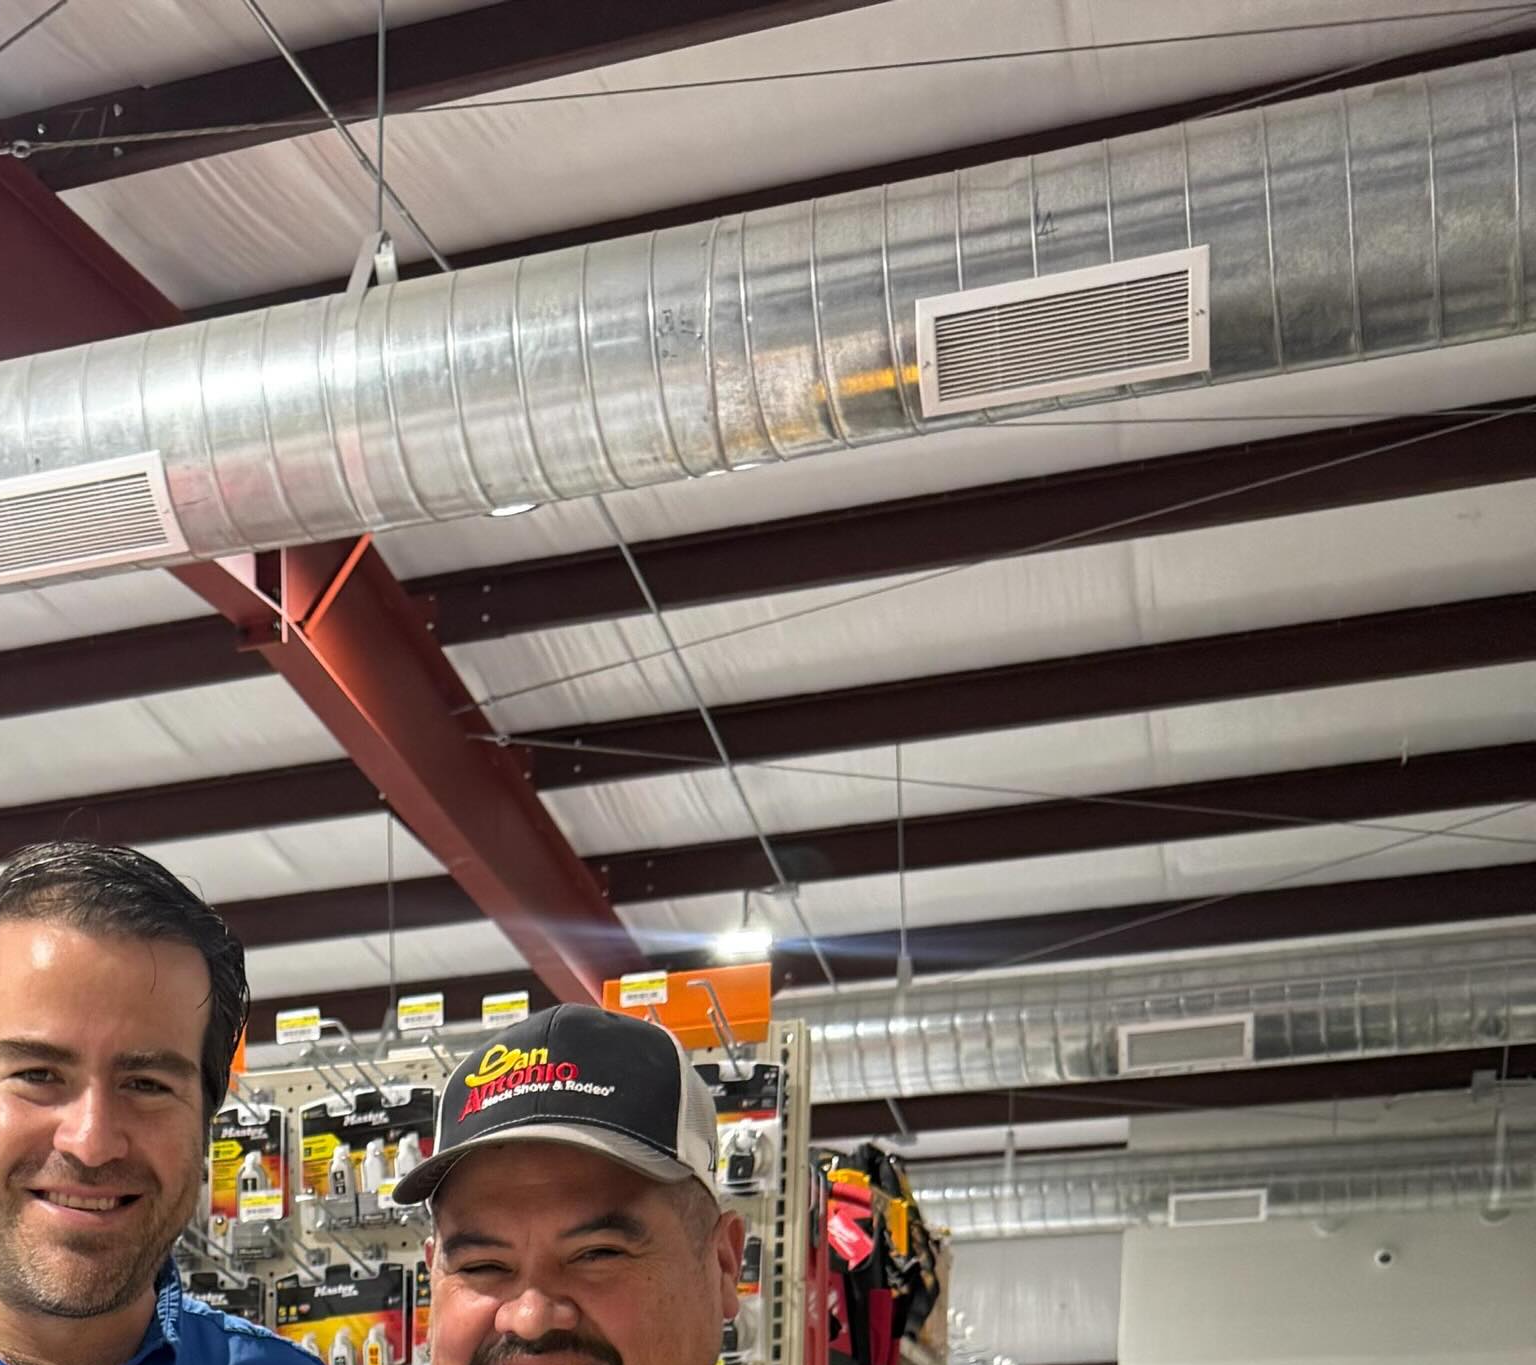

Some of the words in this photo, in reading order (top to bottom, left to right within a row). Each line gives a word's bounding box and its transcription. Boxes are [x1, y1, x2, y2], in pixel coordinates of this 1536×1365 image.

[465, 1044, 548, 1087] San
[458, 1062, 579, 1123] Antonio
[513, 1082, 549, 1097] Show
[552, 1081, 562, 1091] &
